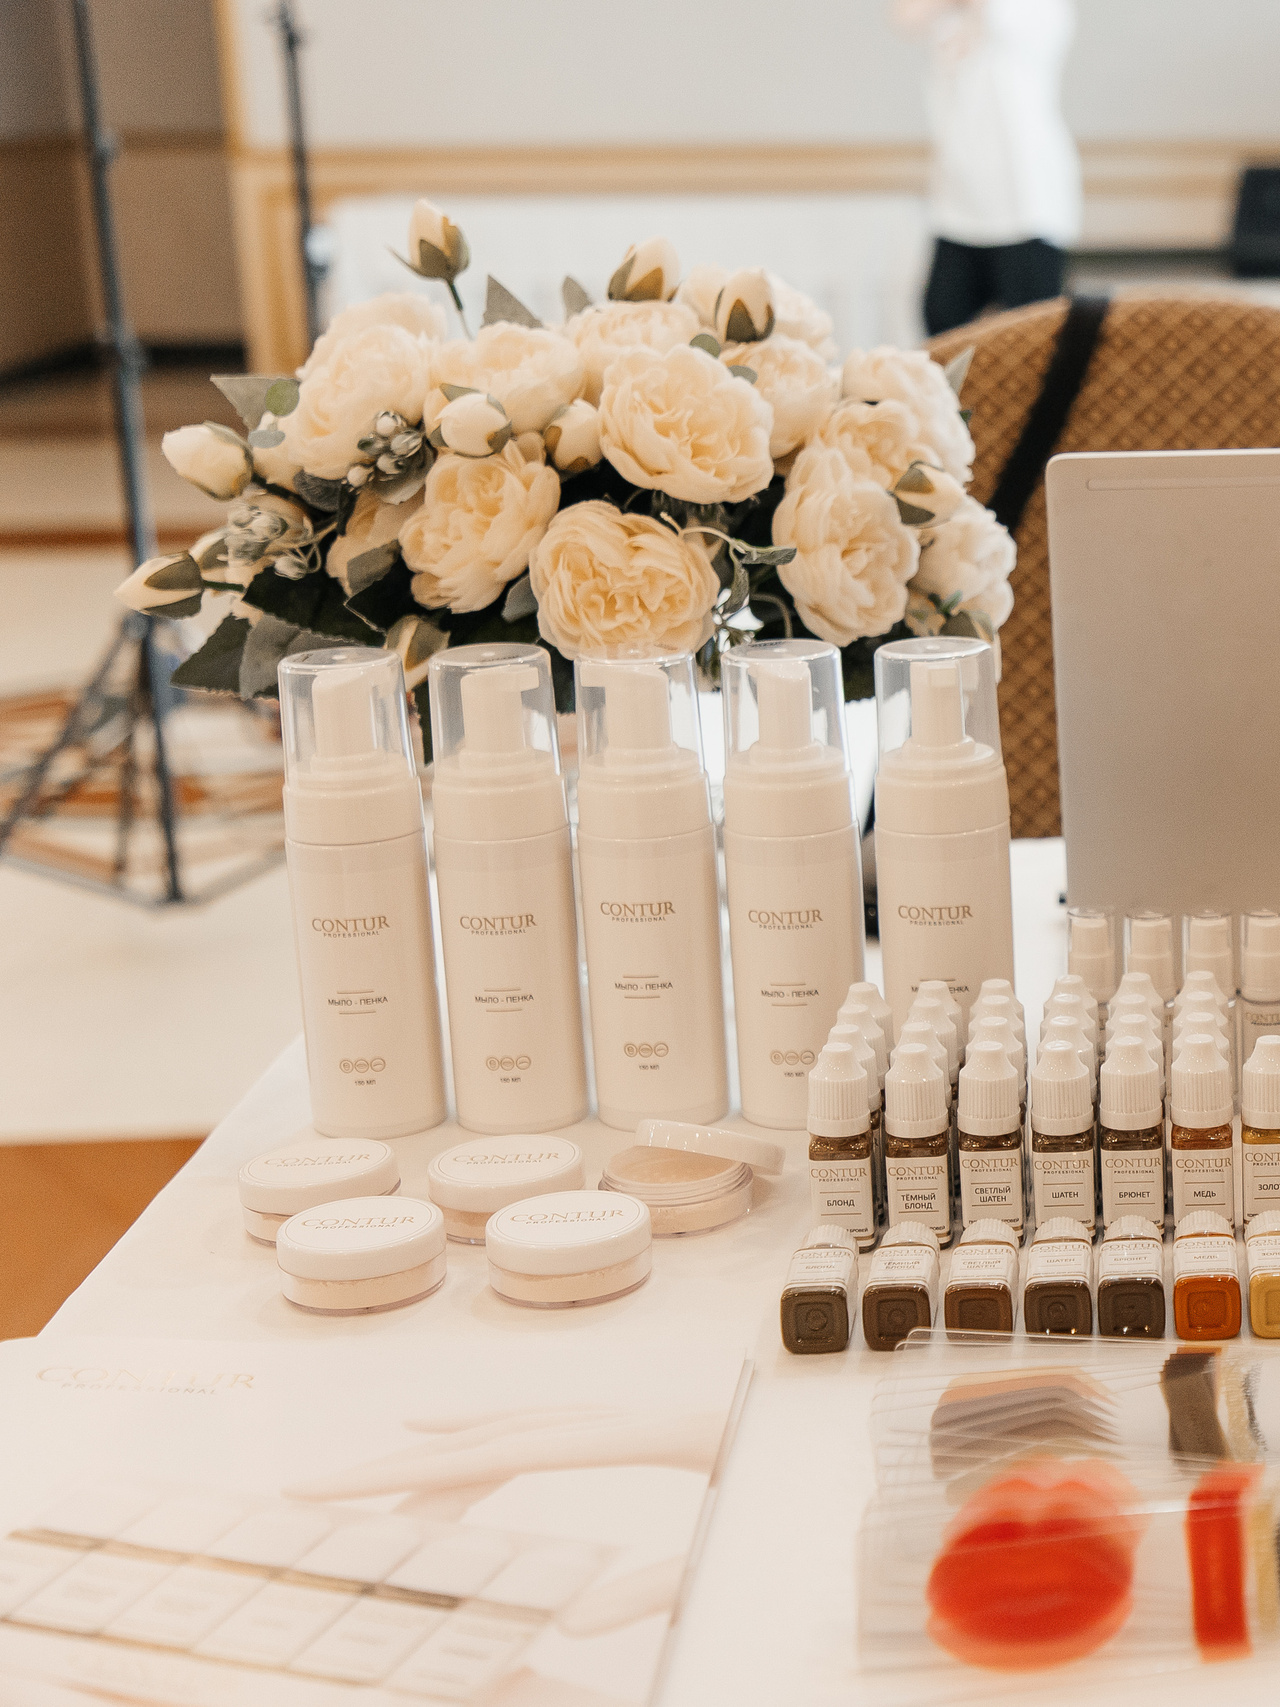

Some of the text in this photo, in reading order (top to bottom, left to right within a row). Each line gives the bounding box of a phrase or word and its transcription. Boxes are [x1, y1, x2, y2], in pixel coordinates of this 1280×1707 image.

[600, 901, 676, 917] CONTUR
[898, 905, 973, 920] CONTUR
[459, 914, 538, 930] CONTUR
[748, 909, 823, 925] CONTUR
[312, 916, 390, 932] CONTUR
[645, 982, 673, 990] ПЕНКА
[506, 994, 534, 1003] ПЕНКА
[791, 989, 819, 998] ПЕНКА
[360, 996, 388, 1005] ПЕНКА
[264, 1154, 370, 1166] CONTUR
[452, 1152, 560, 1162] CONTUR
[962, 1158, 1018, 1168] CONTUR
[1034, 1159, 1091, 1170] CONTUR
[1105, 1158, 1162, 1168] CONTUR
[1176, 1158, 1232, 1168] CONTUR
[811, 1168, 867, 1178] CONTUR
[888, 1166, 945, 1176] CONTUR
[974, 1186, 1011, 1194] СВЕТЛЫЙ
[1052, 1191, 1079, 1199] ШАТЕН
[901, 1192, 936, 1201] ТЁМНЫЙ
[827, 1199, 855, 1207] БЛОНД
[904, 1202, 933, 1210] БЛОНД
[302, 1216, 415, 1226] CONTUR
[510, 1210, 624, 1222] CONTUR
[36, 1367, 255, 1389] CONTUR
